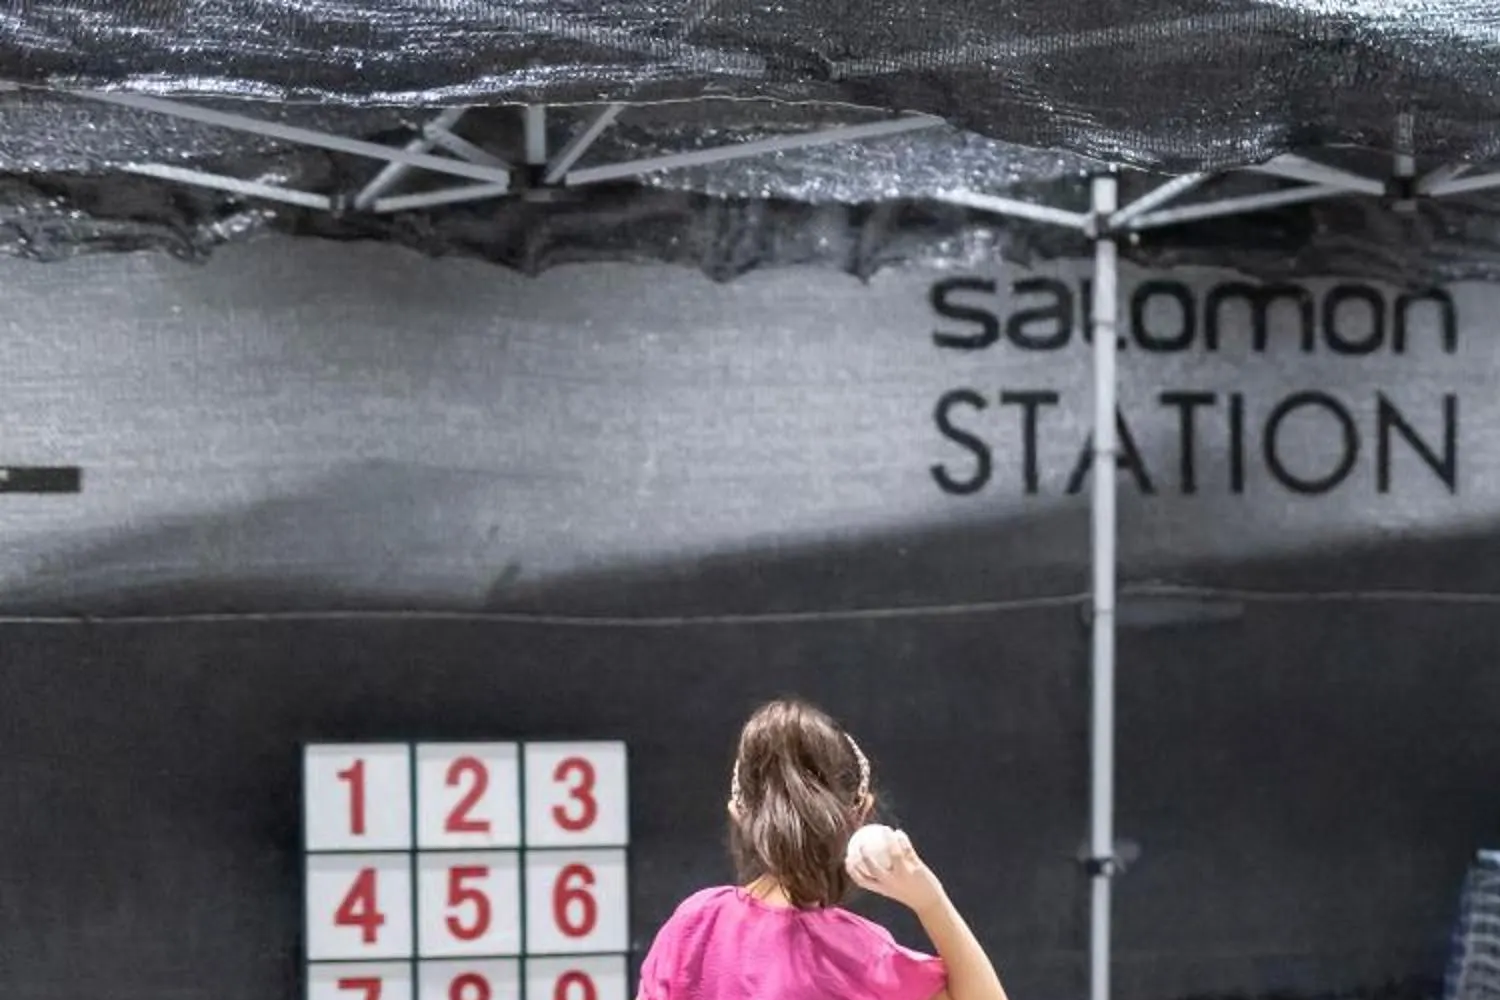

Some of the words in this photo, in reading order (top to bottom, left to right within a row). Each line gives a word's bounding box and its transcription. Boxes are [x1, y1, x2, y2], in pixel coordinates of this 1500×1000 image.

[930, 277, 1458, 355] salomon
[931, 388, 1458, 495] STATION
[337, 759, 365, 834] 1
[445, 757, 490, 833] 2
[552, 757, 598, 832] 3
[334, 867, 385, 943] 4
[446, 865, 492, 941] 5
[552, 863, 597, 938] 6
